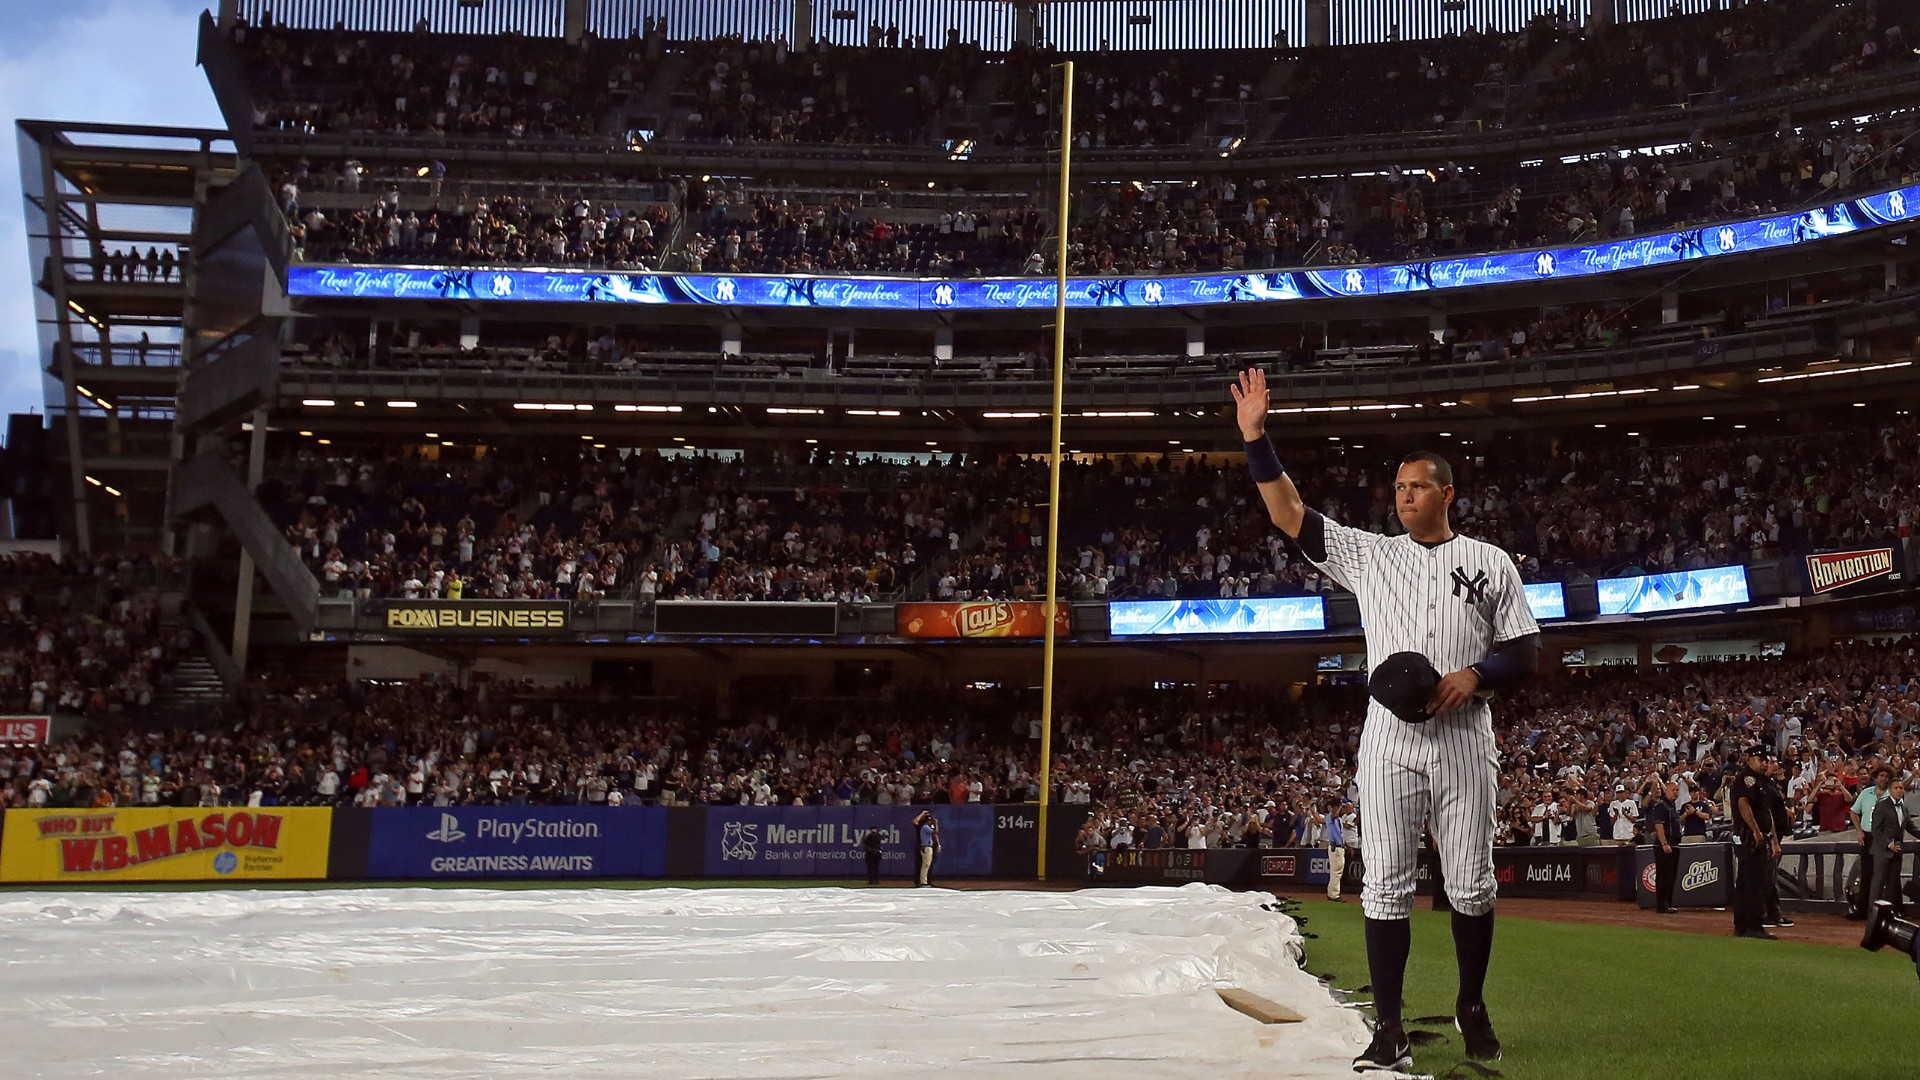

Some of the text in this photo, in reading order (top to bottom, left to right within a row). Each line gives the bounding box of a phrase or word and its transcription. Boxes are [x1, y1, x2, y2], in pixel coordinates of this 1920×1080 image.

[1760, 220, 1790, 240] New
[1581, 236, 1676, 270] New York Yank
[1455, 259, 1508, 286] Yankees
[316, 270, 434, 297] New York Yank
[543, 276, 579, 294] New
[1190, 280, 1222, 296] New
[841, 284, 900, 306] Yankees
[982, 284, 1016, 302] New
[1016, 284, 1050, 305] York
[1811, 551, 1890, 589] ADMIRATION
[1450, 566, 1489, 605] NY
[387, 608, 564, 628] FOX BUSINESS
[961, 603, 1010, 636] Lay's
[1602, 656, 1634, 667] CHICKEN
[0, 722, 37, 741] L'S
[38, 815, 115, 835] WHO BUT
[477, 817, 599, 844] PlayStation
[766, 823, 900, 847] Merrill Lych
[216, 853, 237, 874] hp
[430, 854, 594, 873] GREATNESS AWAITS
[765, 849, 906, 860] Bank of America Coration
[1267, 859, 1295, 872] CHIPOTLE
[1496, 863, 1515, 883] udi
[1526, 863, 1572, 881] Audi A4
[1691, 863, 1710, 877] OXI
[1684, 870, 1716, 888] CLEAN
